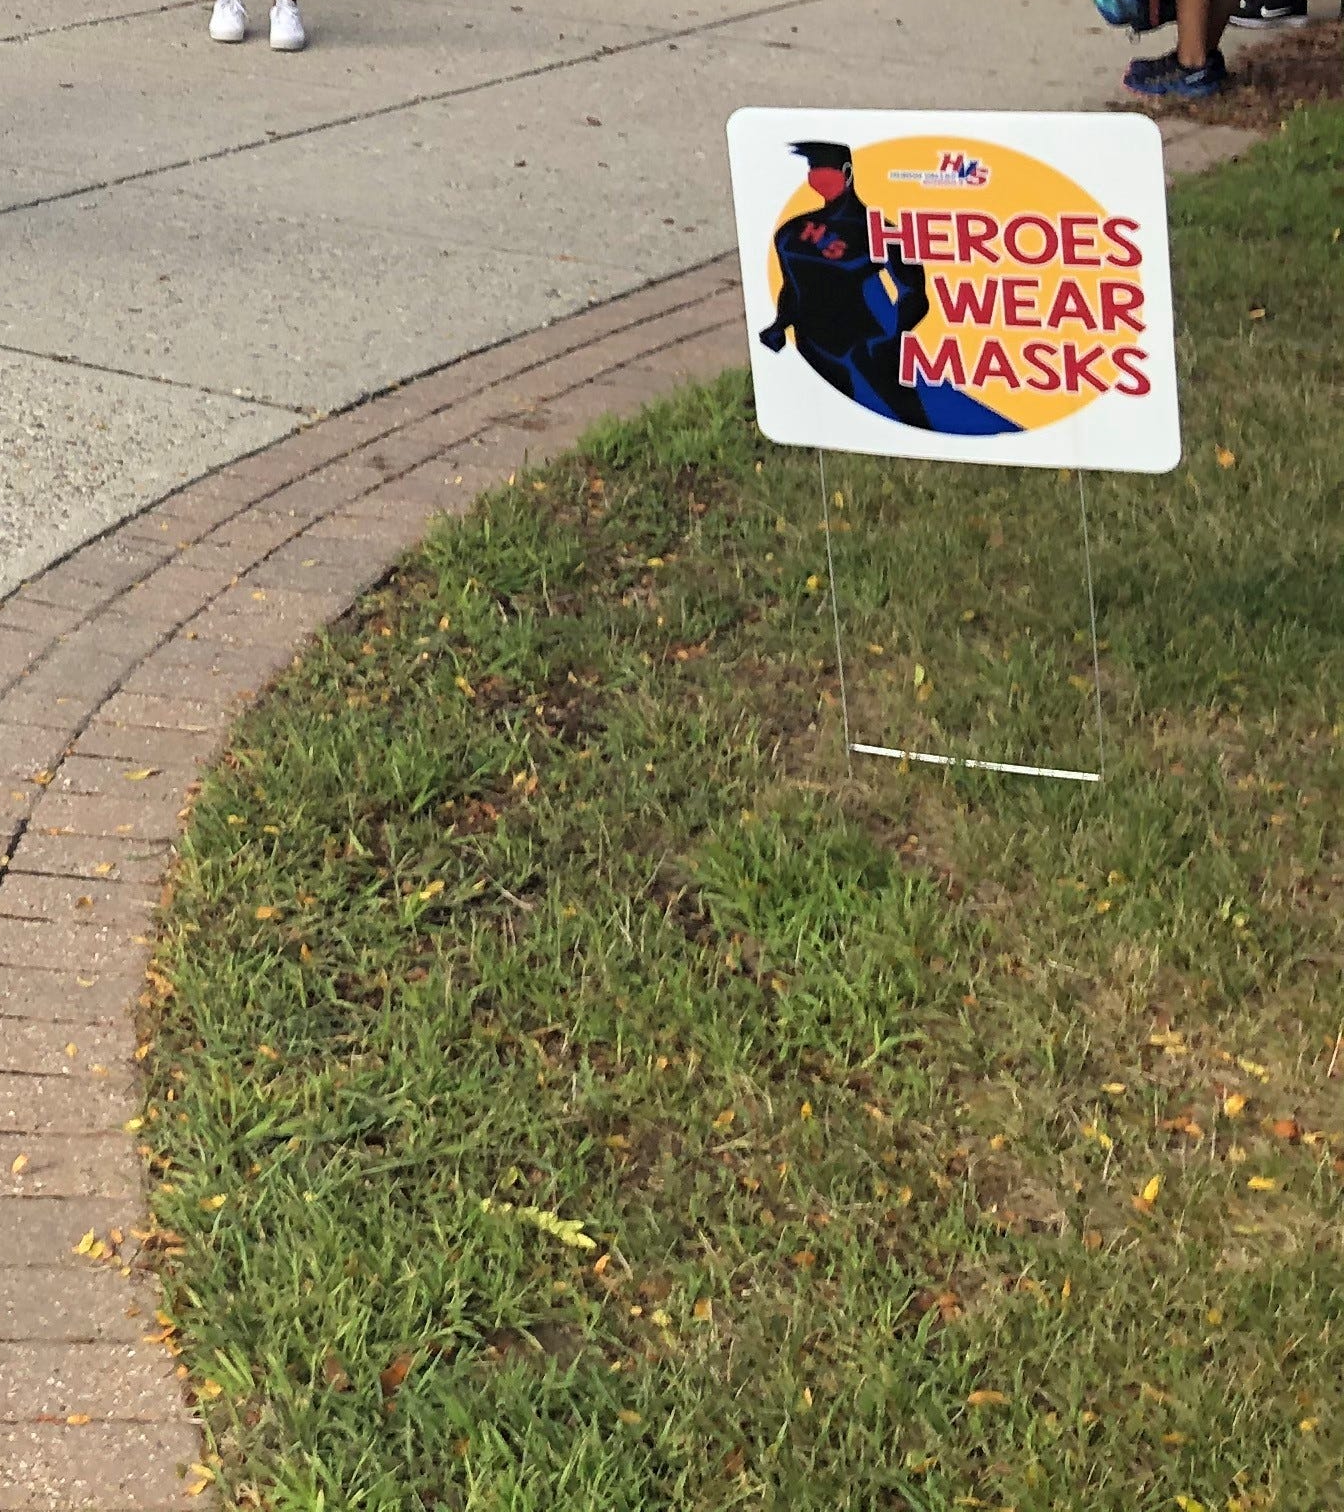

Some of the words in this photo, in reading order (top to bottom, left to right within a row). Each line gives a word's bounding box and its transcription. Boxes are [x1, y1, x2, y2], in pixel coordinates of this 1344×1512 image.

[868, 210, 1143, 268] HEROES
[934, 276, 1146, 333] WEAR
[900, 335, 1152, 396] MASKS
